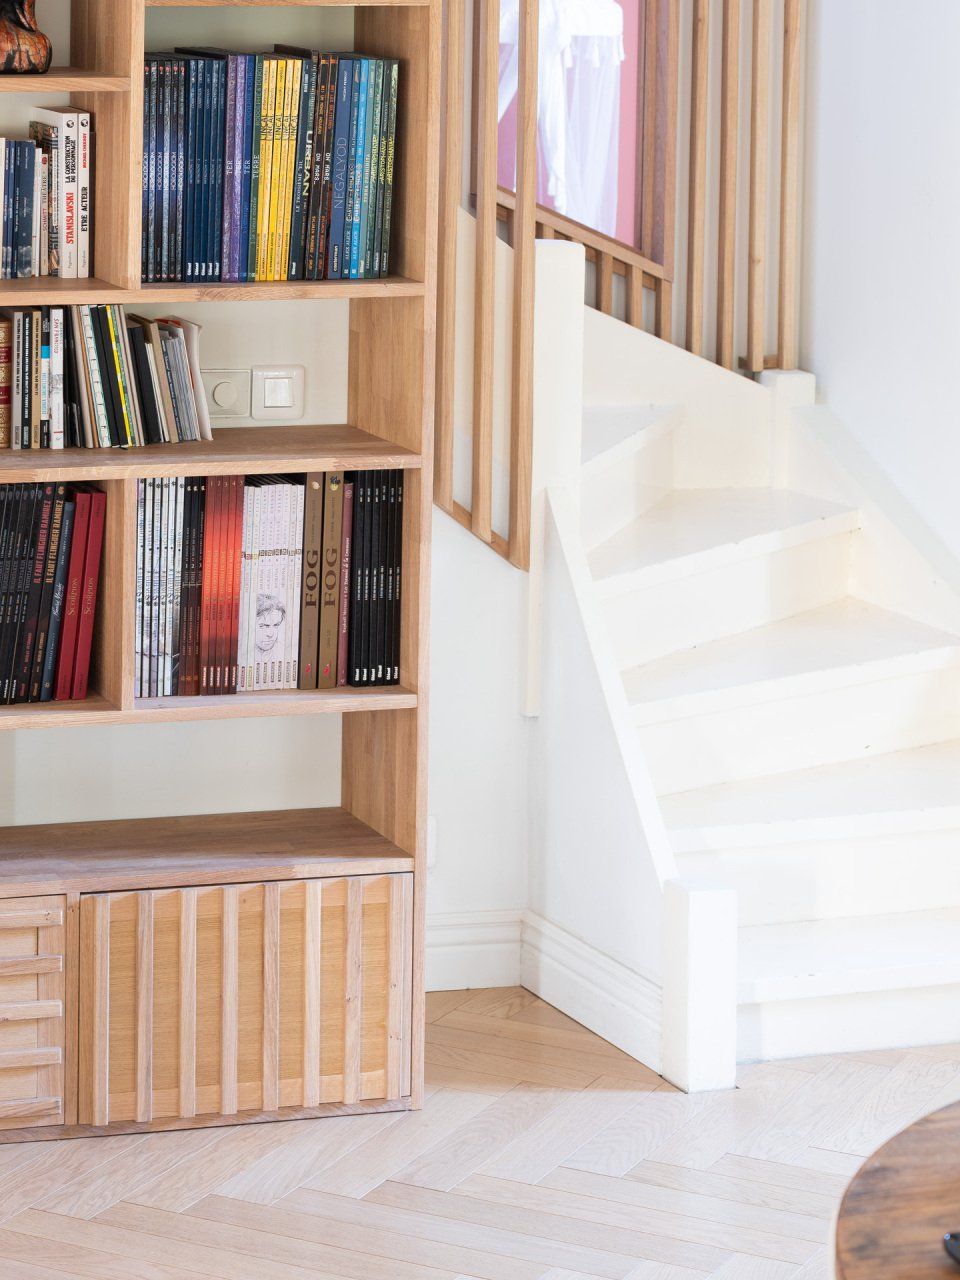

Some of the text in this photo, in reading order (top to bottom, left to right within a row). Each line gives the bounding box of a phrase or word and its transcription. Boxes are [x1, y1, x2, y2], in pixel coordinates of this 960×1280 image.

[303, 130, 313, 196] URBAN
[334, 138, 347, 208] NEGALYOD
[66, 192, 74, 244] STANISLAVSKI
[41, 500, 51, 528] RAMIREZ
[54, 500, 64, 528] RAMIREZ
[36, 529, 47, 560] FLINGUER
[49, 529, 59, 559] FLINGUER
[35, 561, 44, 576] FAUT
[47, 561, 55, 576] FAUT
[304, 550, 317, 608] FOG
[324, 548, 337, 607] FOG
[67, 578, 79, 616] SCORPION
[84, 577, 94, 614] SCORPION
